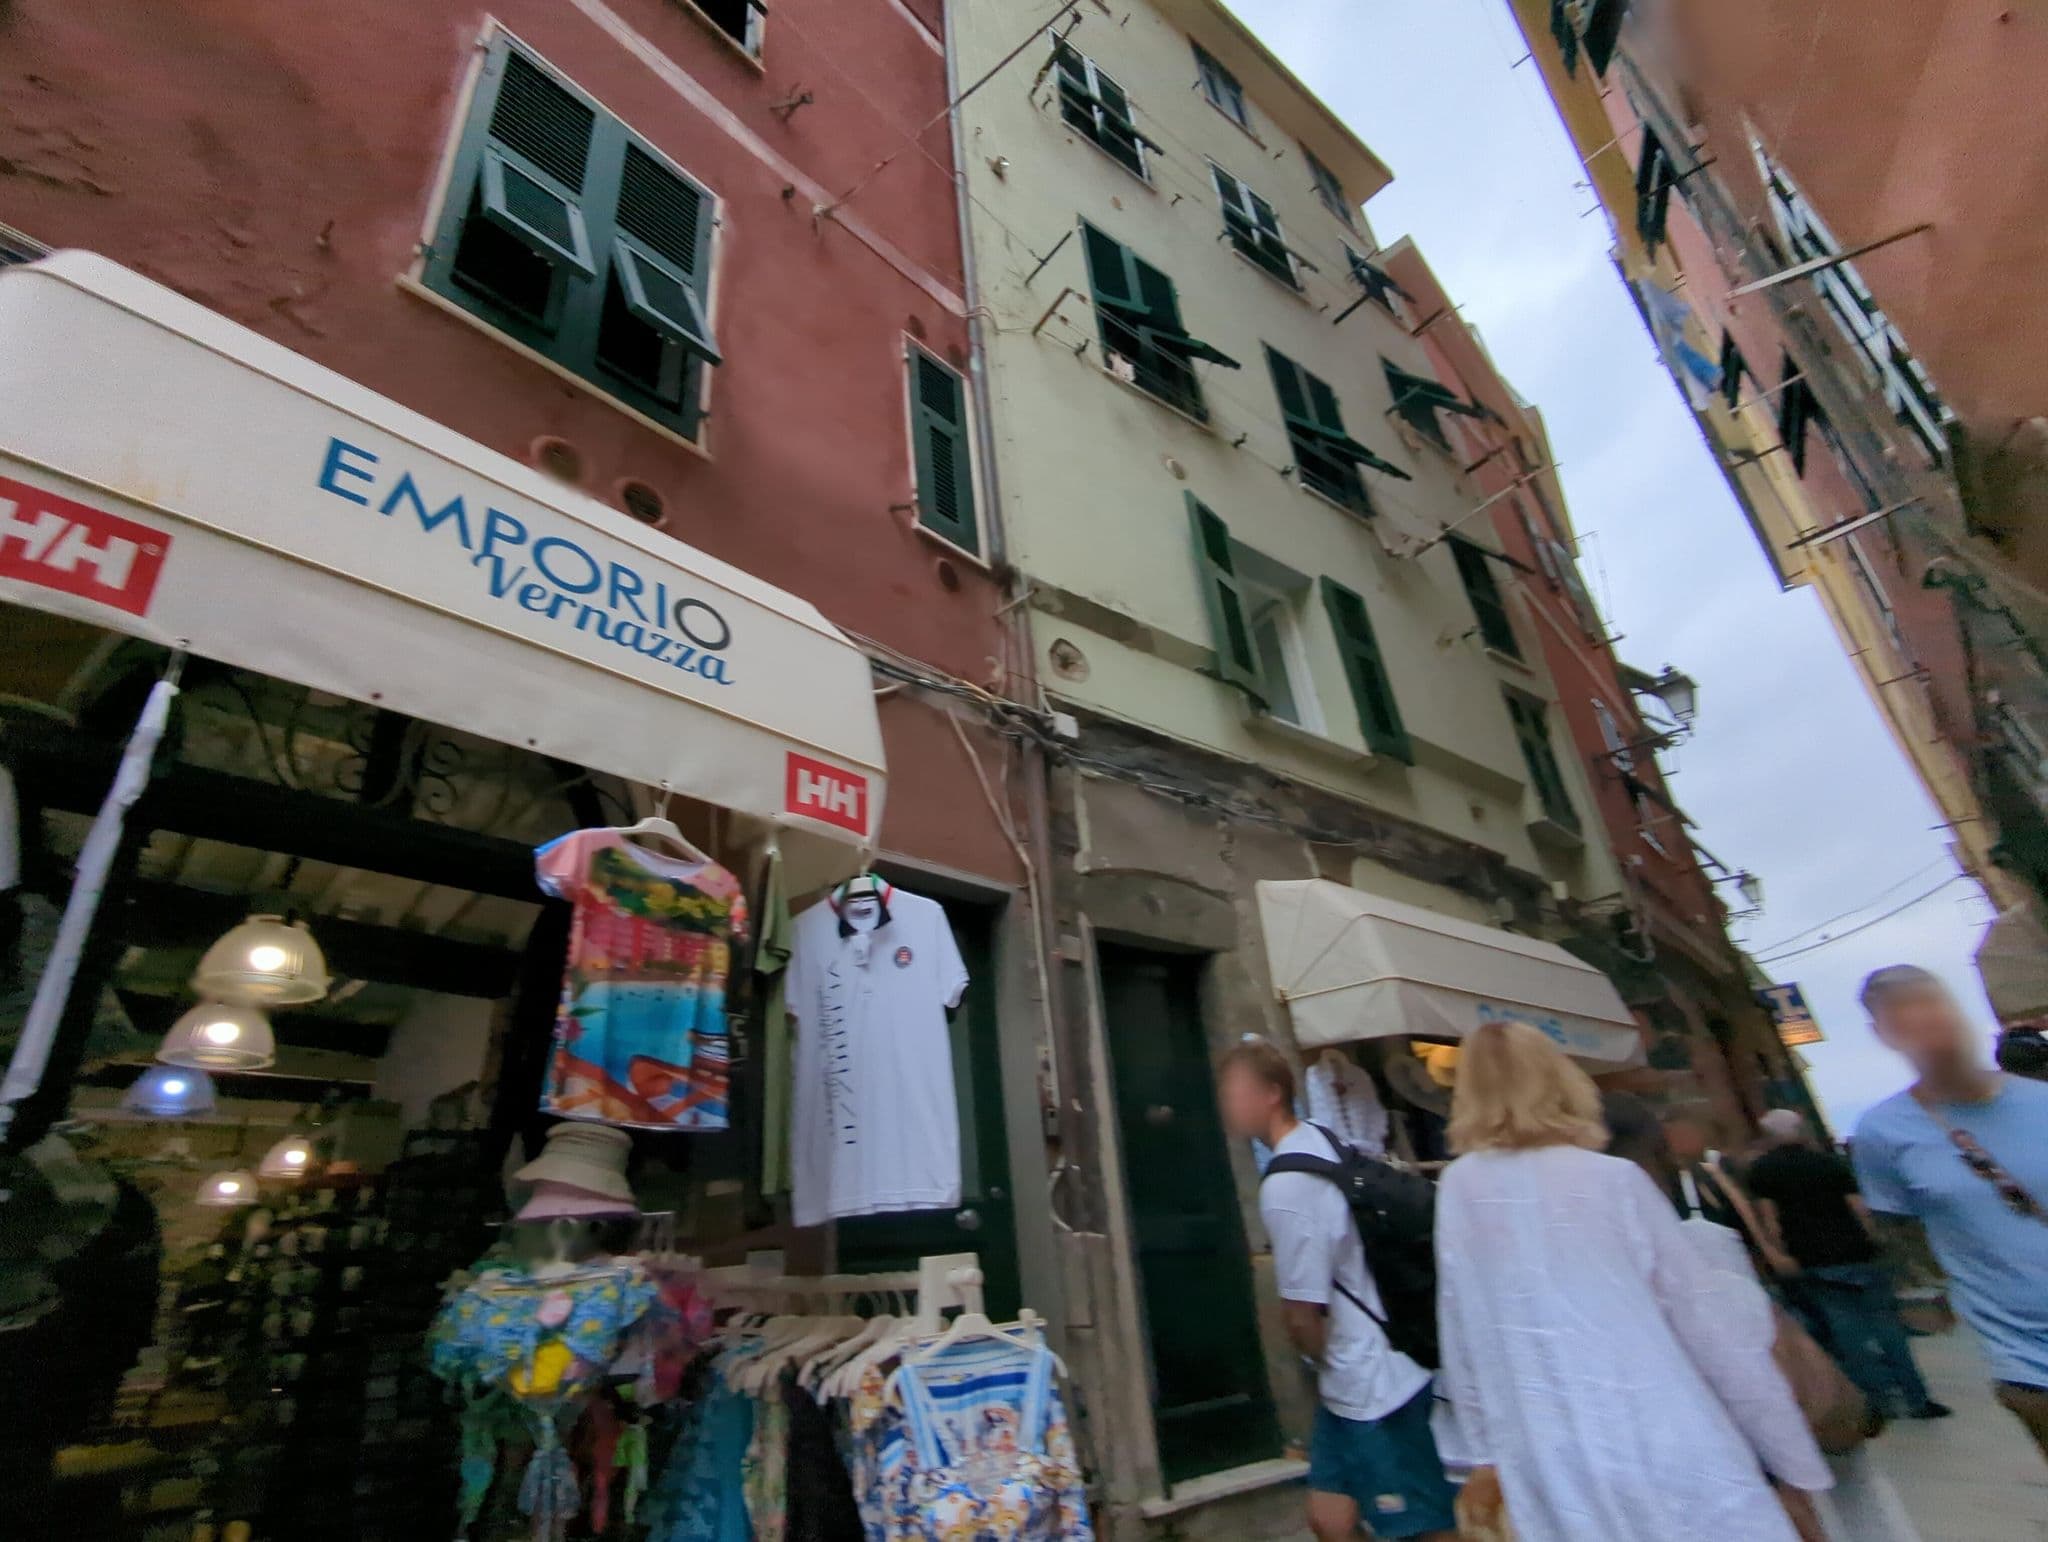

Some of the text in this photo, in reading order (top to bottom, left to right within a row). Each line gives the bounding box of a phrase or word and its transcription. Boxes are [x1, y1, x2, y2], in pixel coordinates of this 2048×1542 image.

[318, 436, 731, 650] EMPORIO
[471, 551, 736, 686] Vernazza
[797, 768, 858, 819] HH
